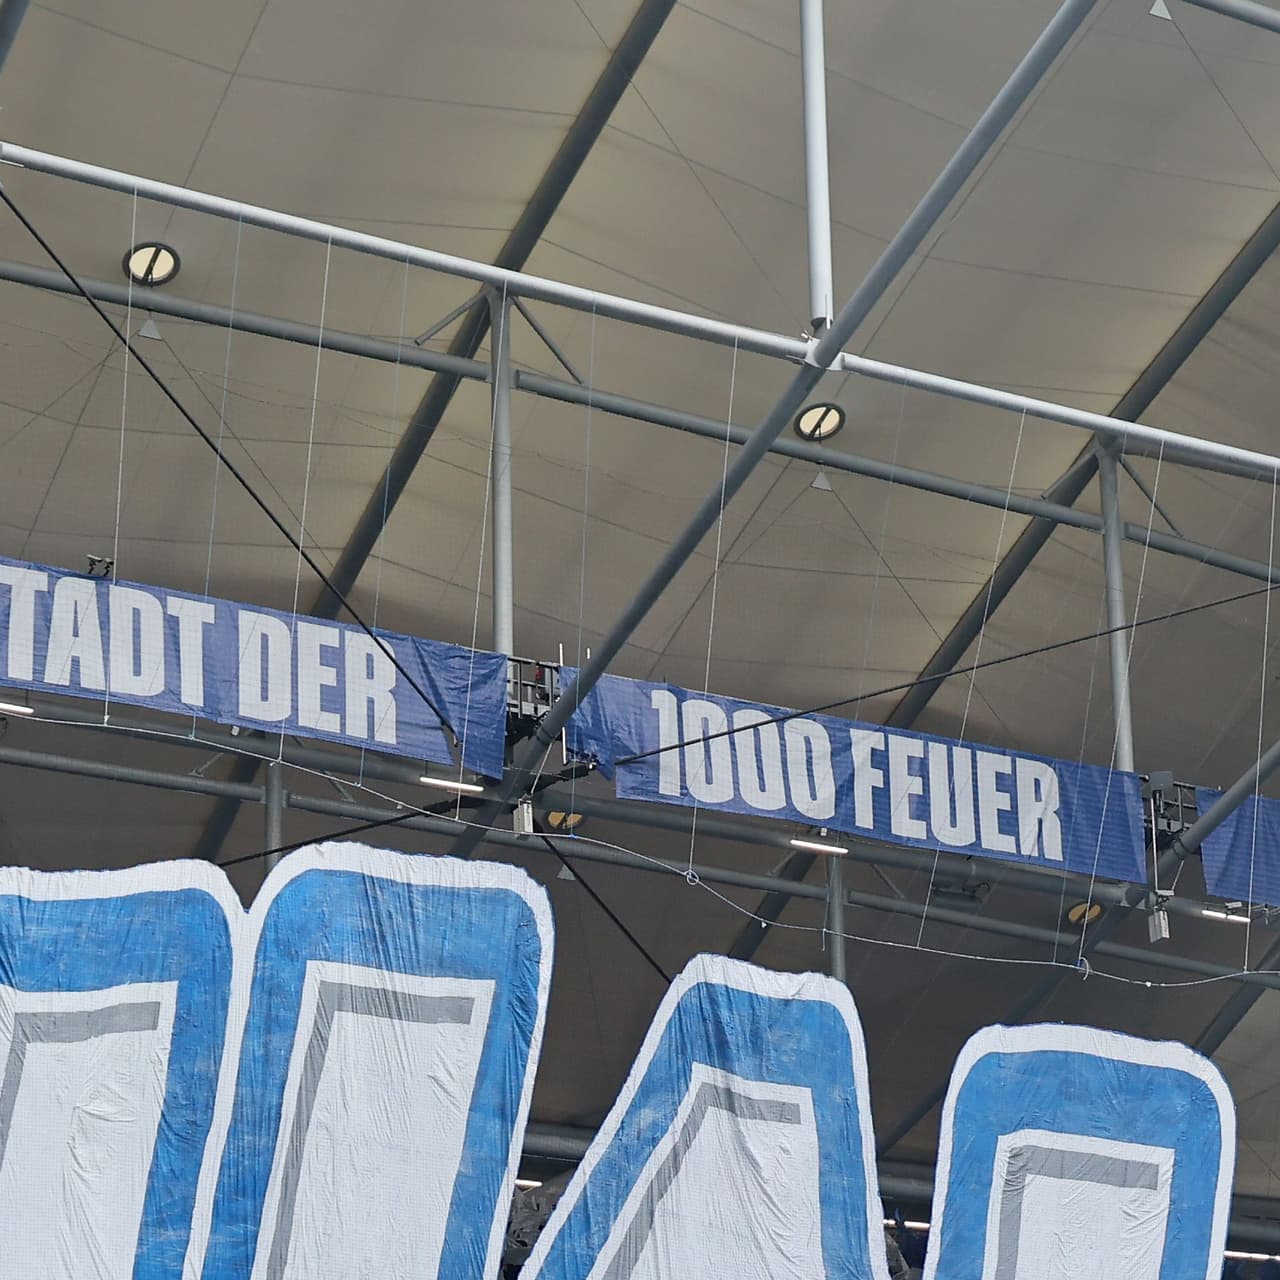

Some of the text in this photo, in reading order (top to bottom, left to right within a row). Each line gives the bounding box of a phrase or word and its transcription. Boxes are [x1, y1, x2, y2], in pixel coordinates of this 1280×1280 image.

[238, 610, 397, 745] DER
[651, 689, 1064, 861] 1000 FEUER
